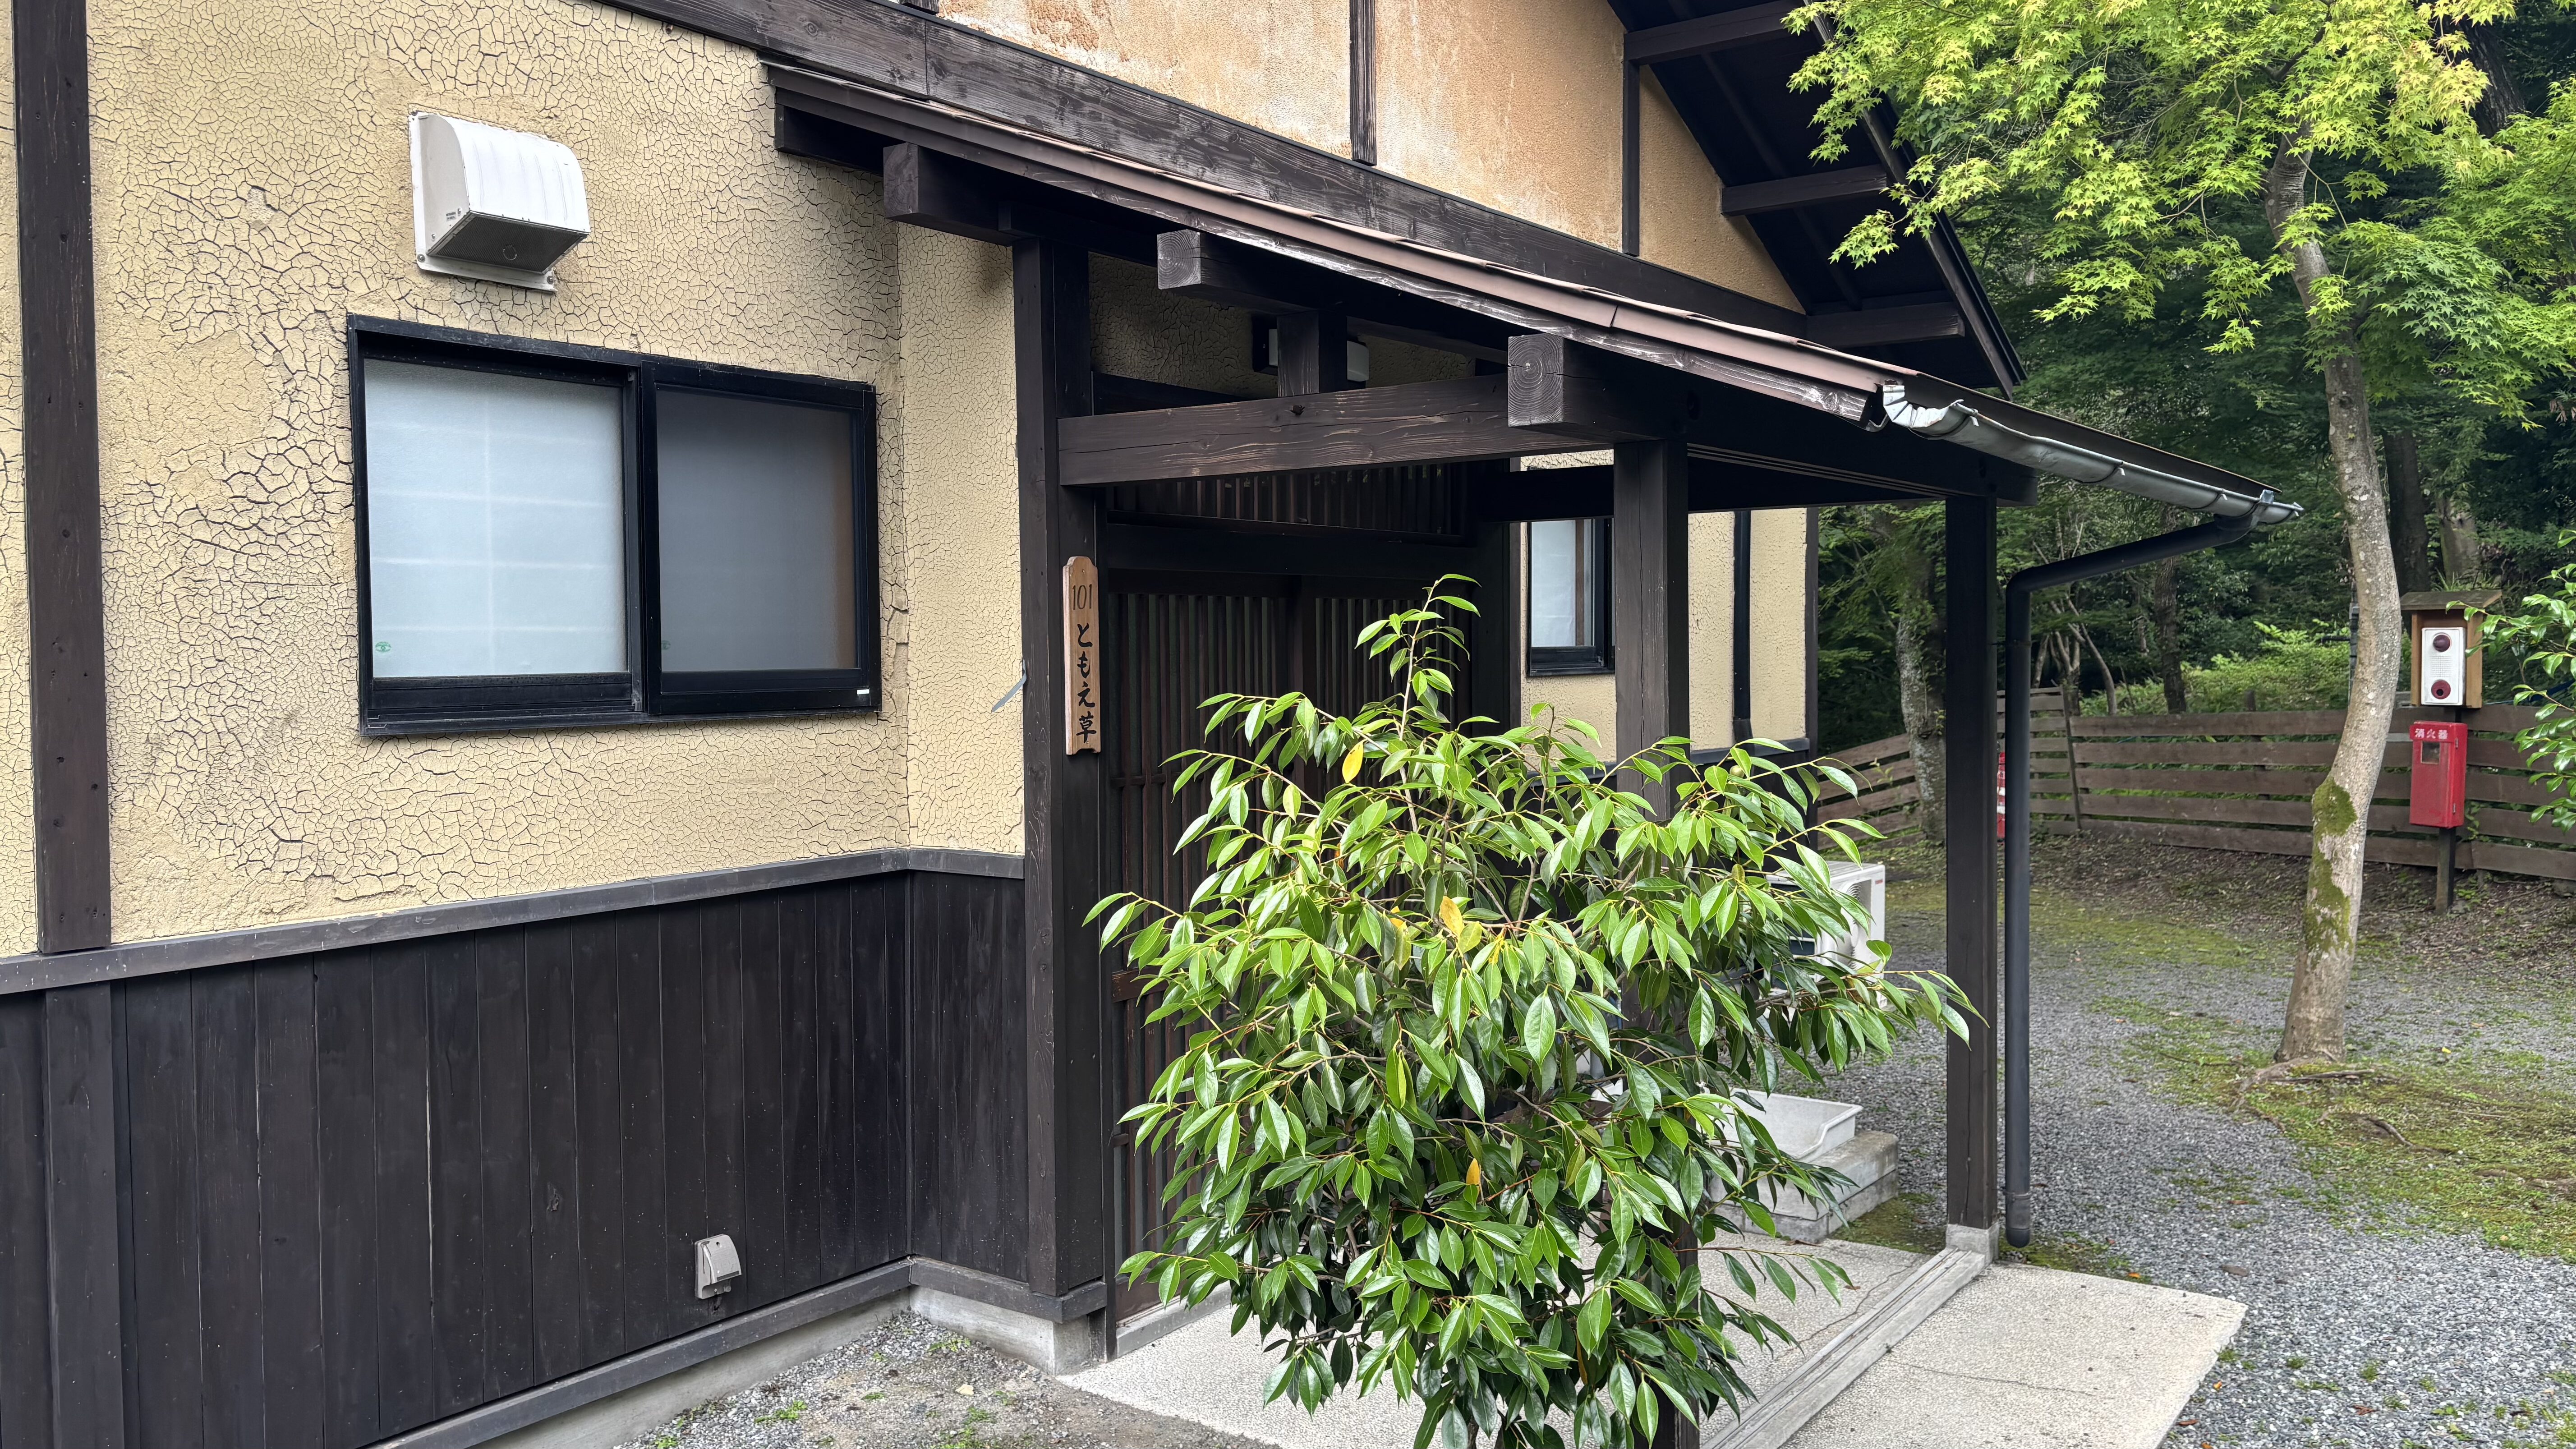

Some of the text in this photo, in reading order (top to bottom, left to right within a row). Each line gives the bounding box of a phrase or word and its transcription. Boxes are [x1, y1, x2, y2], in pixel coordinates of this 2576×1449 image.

[1072, 584, 1093, 610] 101
[1076, 623, 1096, 744] ともえ草
[2415, 728, 2448, 739] 消火器
